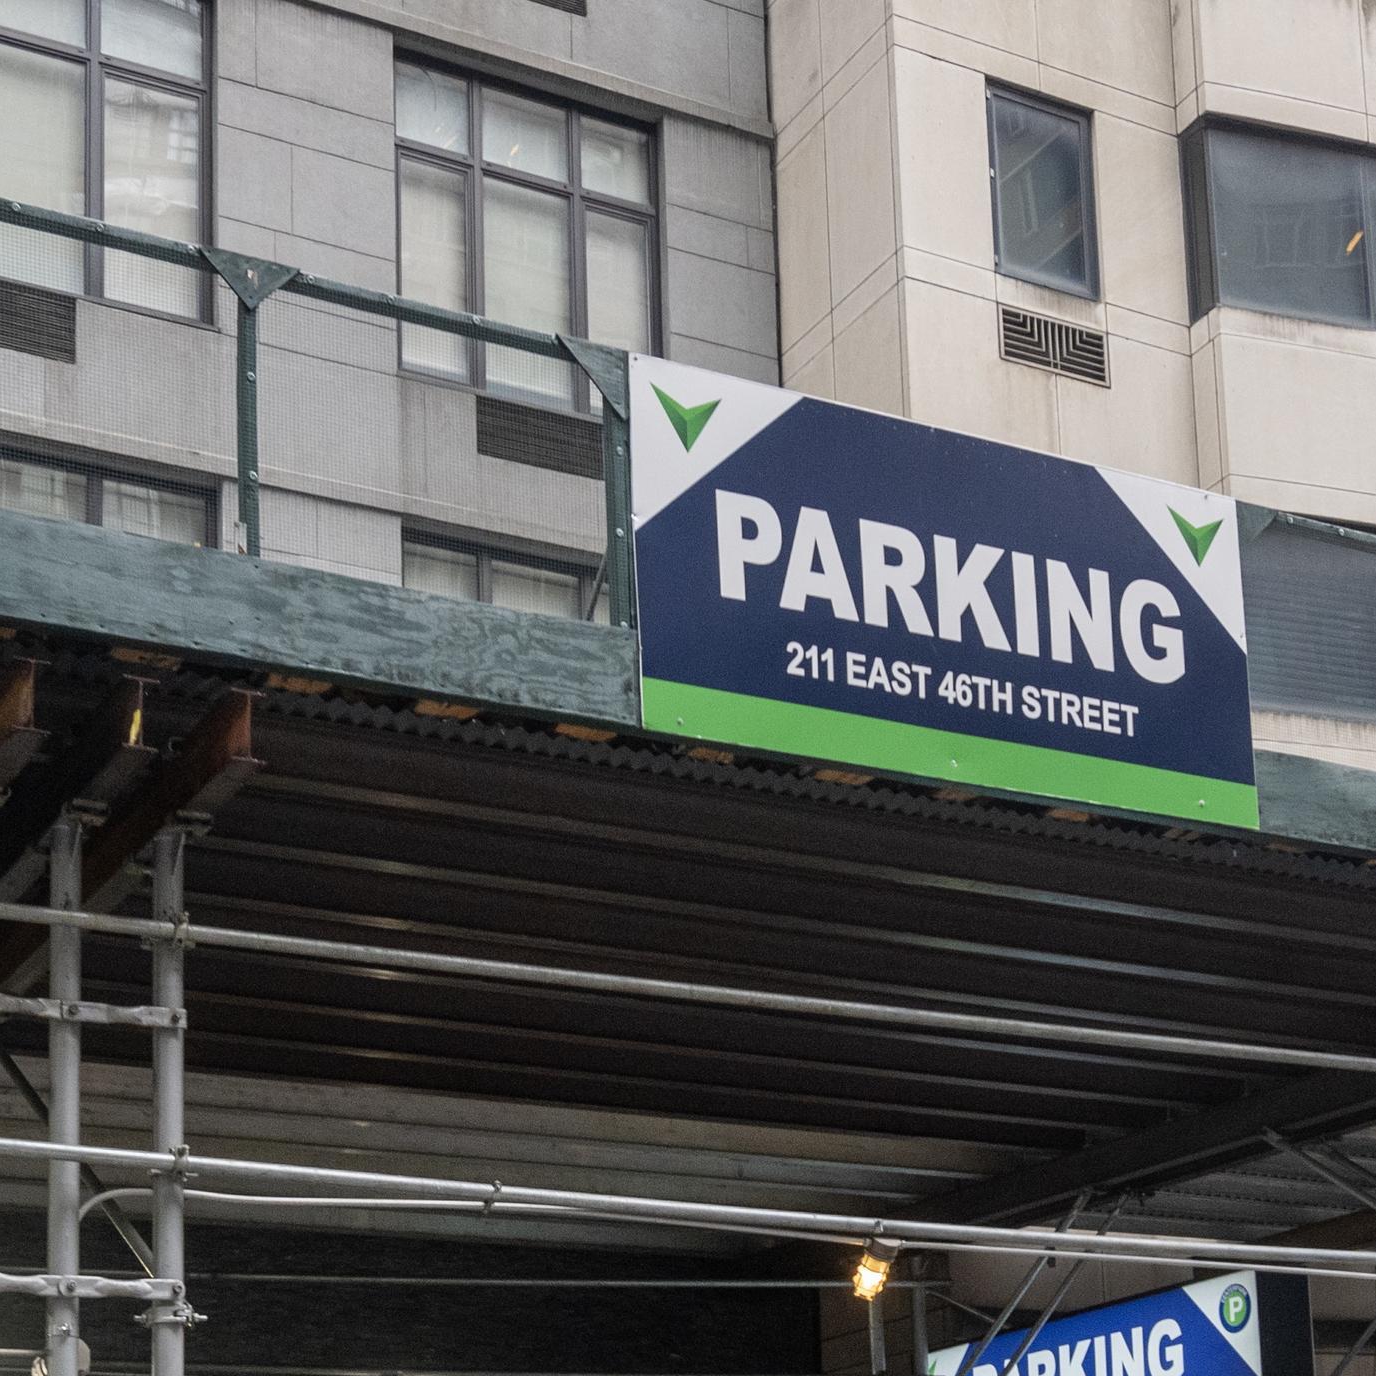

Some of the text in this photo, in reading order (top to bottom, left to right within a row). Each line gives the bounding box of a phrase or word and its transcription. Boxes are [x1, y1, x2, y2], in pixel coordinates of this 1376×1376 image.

[715, 489, 1186, 685] PARKING
[785, 641, 1139, 738] 211 EAST 46TH STREET
